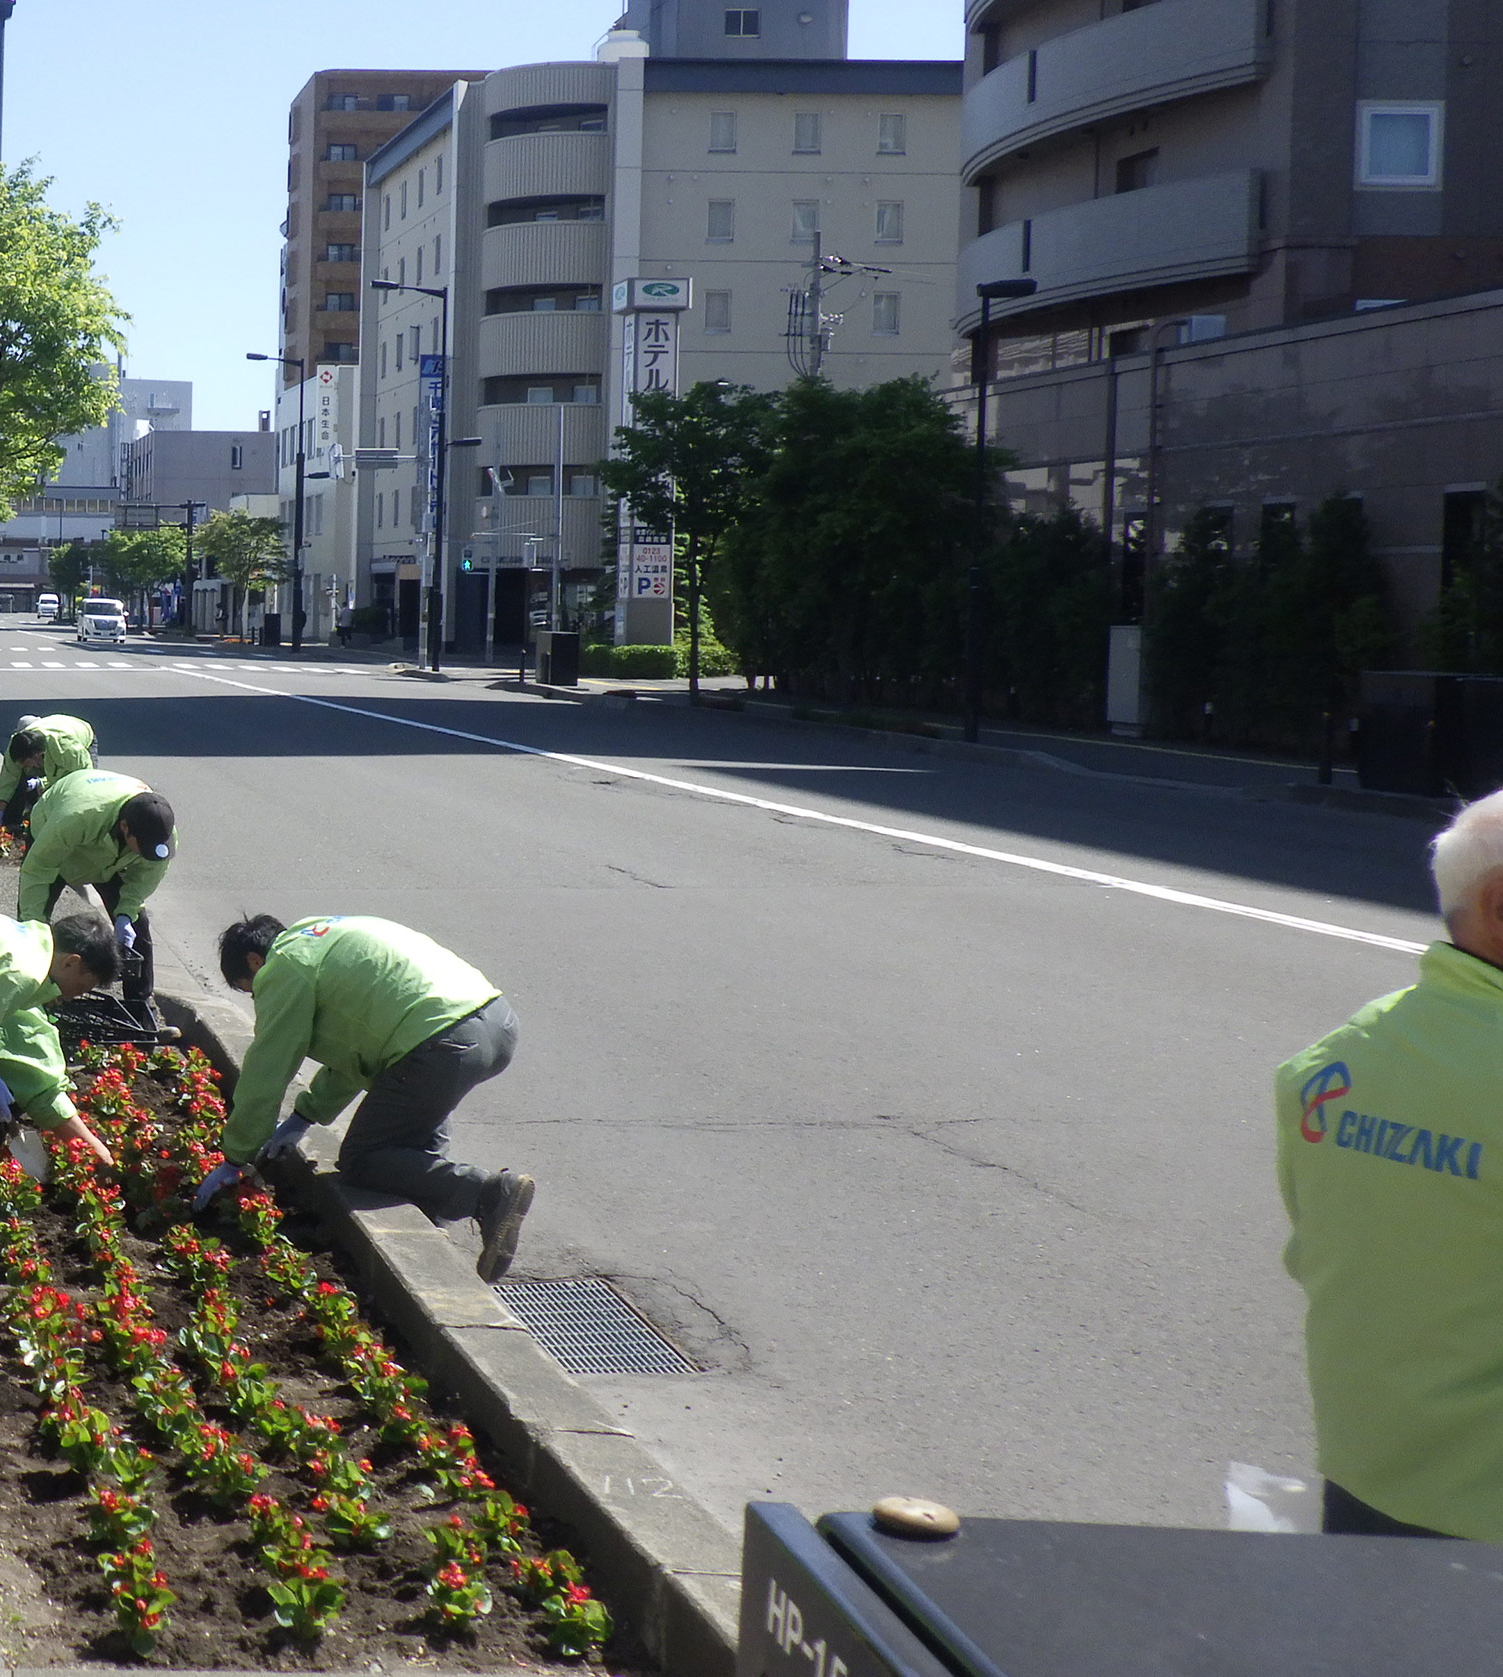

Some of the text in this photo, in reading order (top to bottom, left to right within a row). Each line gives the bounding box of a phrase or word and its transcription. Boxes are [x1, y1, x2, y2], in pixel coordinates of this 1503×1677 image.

[321, 396, 331, 440] 日本生命
[638, 577, 651, 594] P
[1336, 1110, 1483, 1180] CHIZAKI
